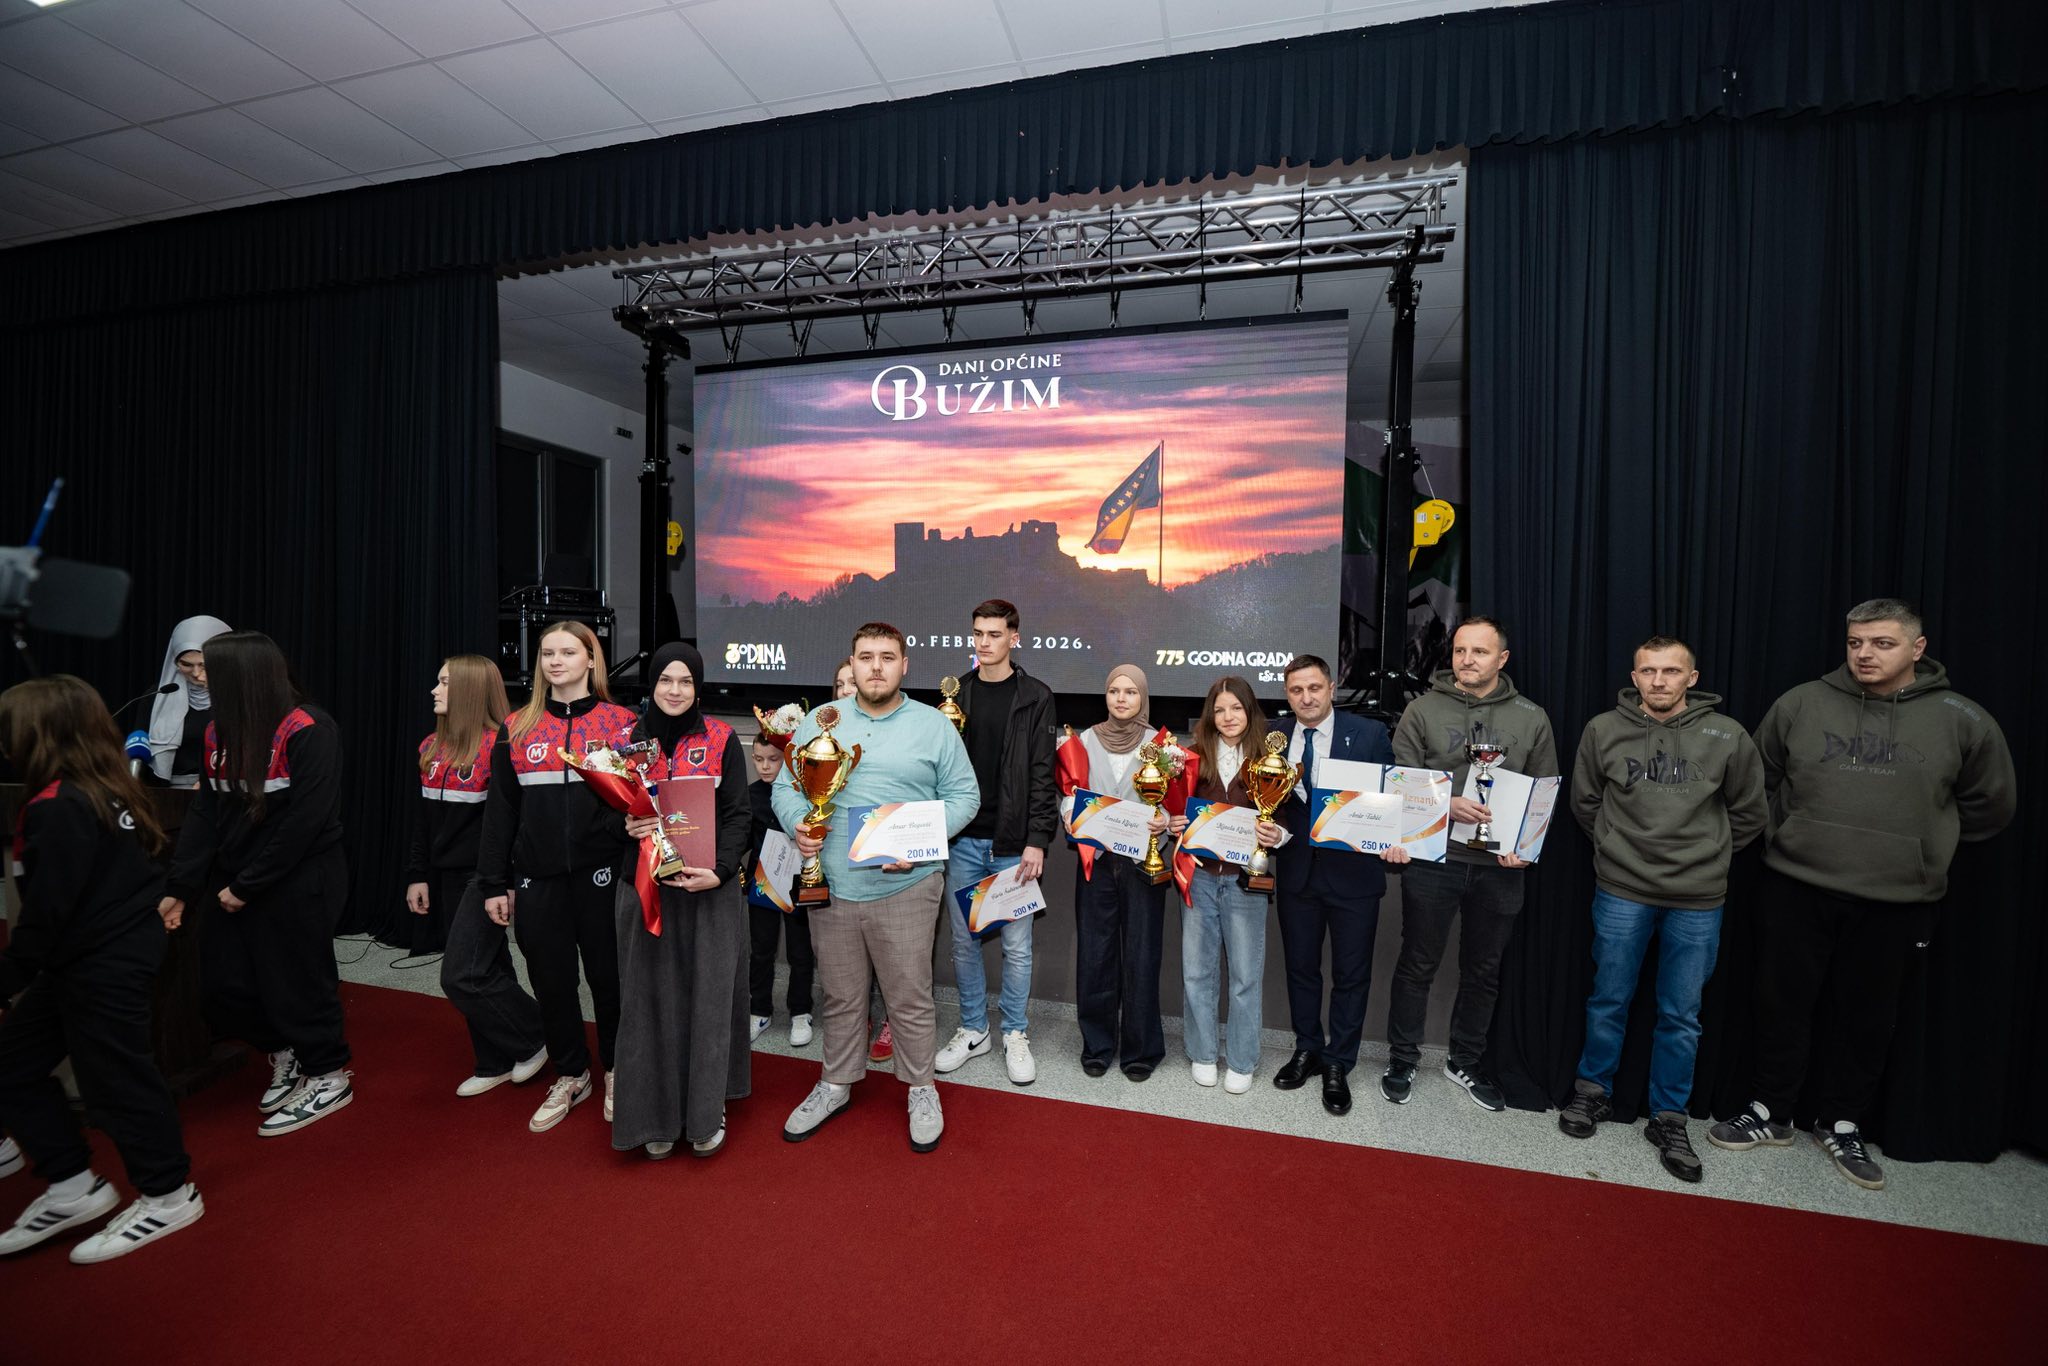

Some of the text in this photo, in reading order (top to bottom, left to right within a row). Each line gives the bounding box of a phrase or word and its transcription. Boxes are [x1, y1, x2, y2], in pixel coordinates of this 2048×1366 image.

[939, 353, 1062, 376] DANI OPĆINE
[871, 365, 1062, 421] BUŽIM
[1032, 636, 1092, 650] 2026.
[1156, 649, 1185, 666] 775
[1187, 650, 1246, 666] GODINA
[1113, 842, 1140, 855] 200 KM
[1361, 840, 1377, 850] 250
[907, 848, 939, 858] 200 KM
[1226, 850, 1240, 860] 200
[1013, 901, 1039, 917] 200 KM
